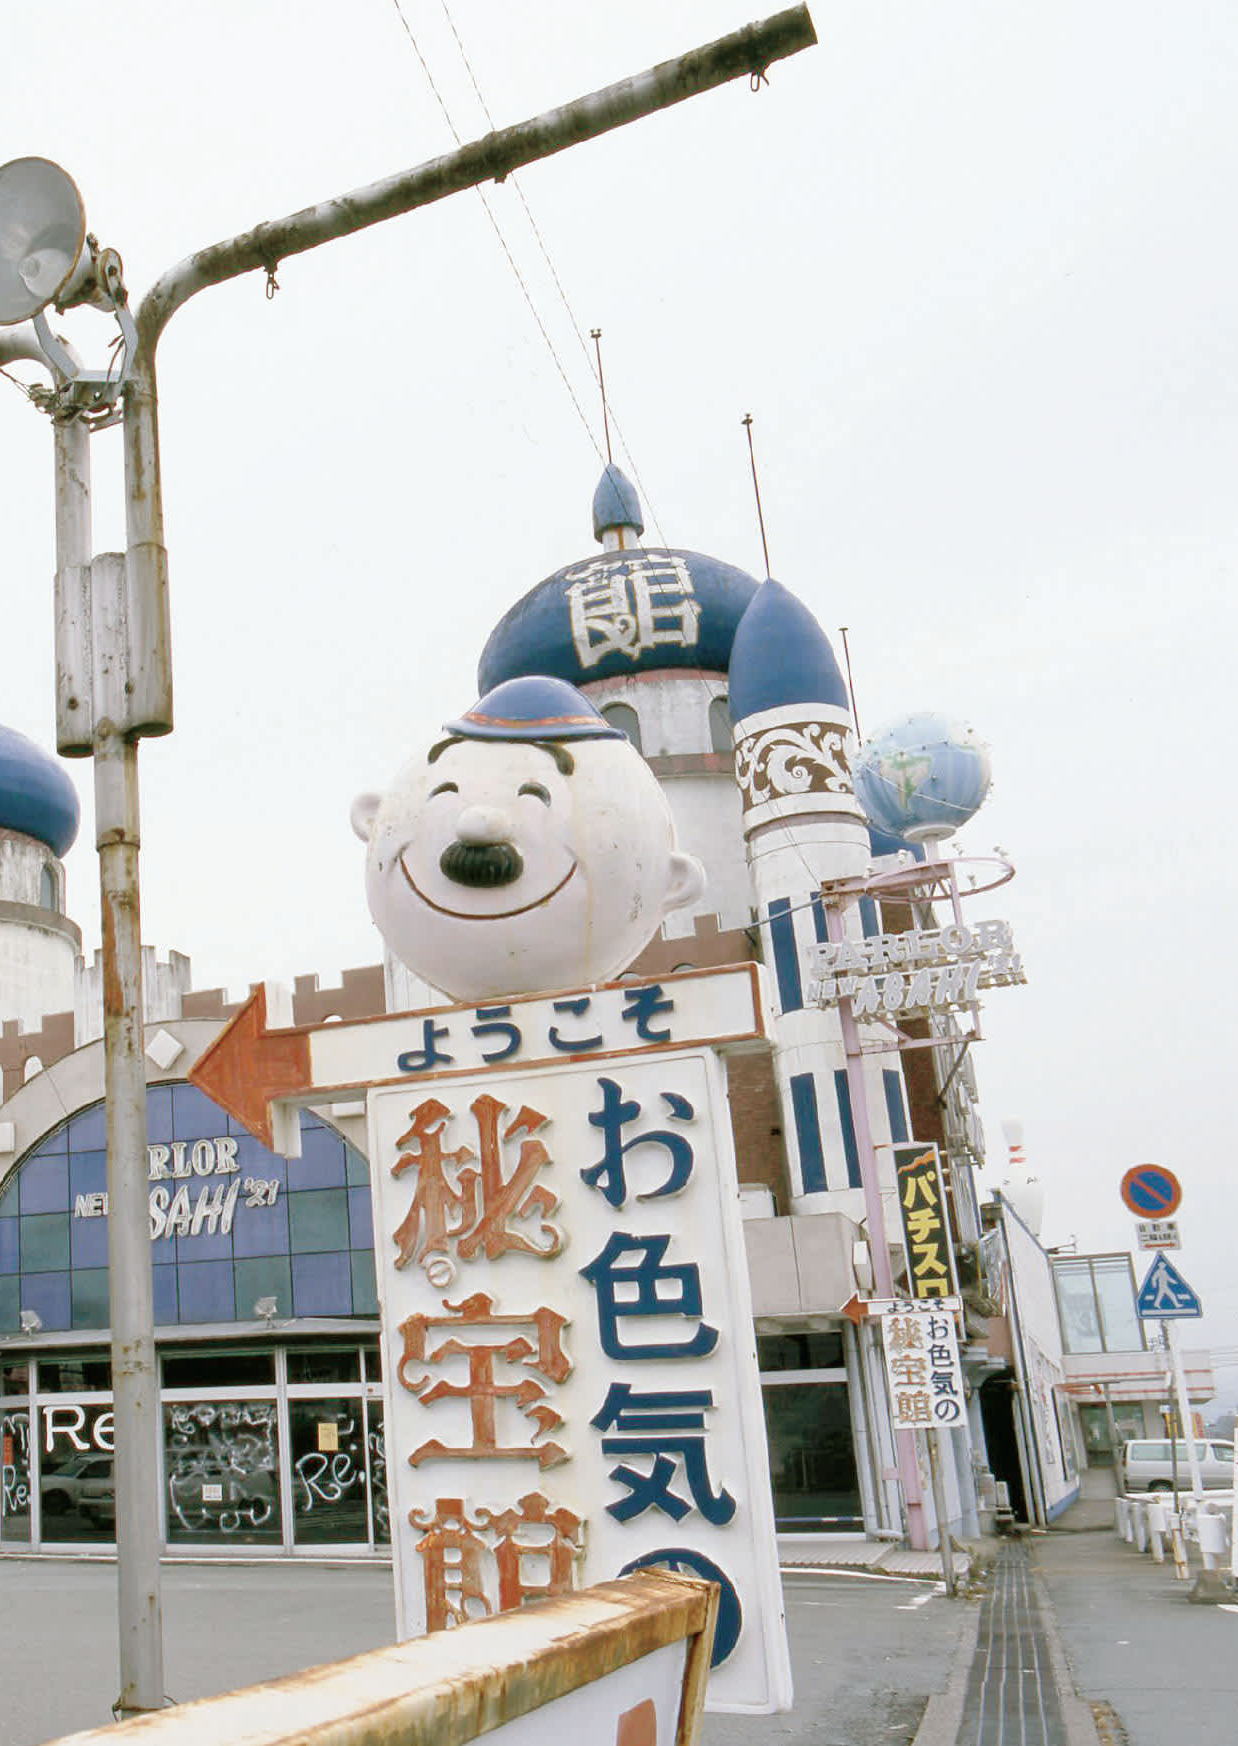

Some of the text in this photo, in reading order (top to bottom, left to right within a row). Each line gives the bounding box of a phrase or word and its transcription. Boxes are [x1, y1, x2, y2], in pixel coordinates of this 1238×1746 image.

[806, 920, 1014, 970] PARLOR
[397, 985, 674, 1072] ようこそ
[146, 1136, 240, 1181] RLOR
[74, 1191, 109, 1218] NE
[147, 1177, 241, 1240] SAHI
[887, 1298, 945, 1314] ようこそ
[886, 1317, 933, 1425] 秘宝館
[927, 1315, 961, 1423] お色気の
